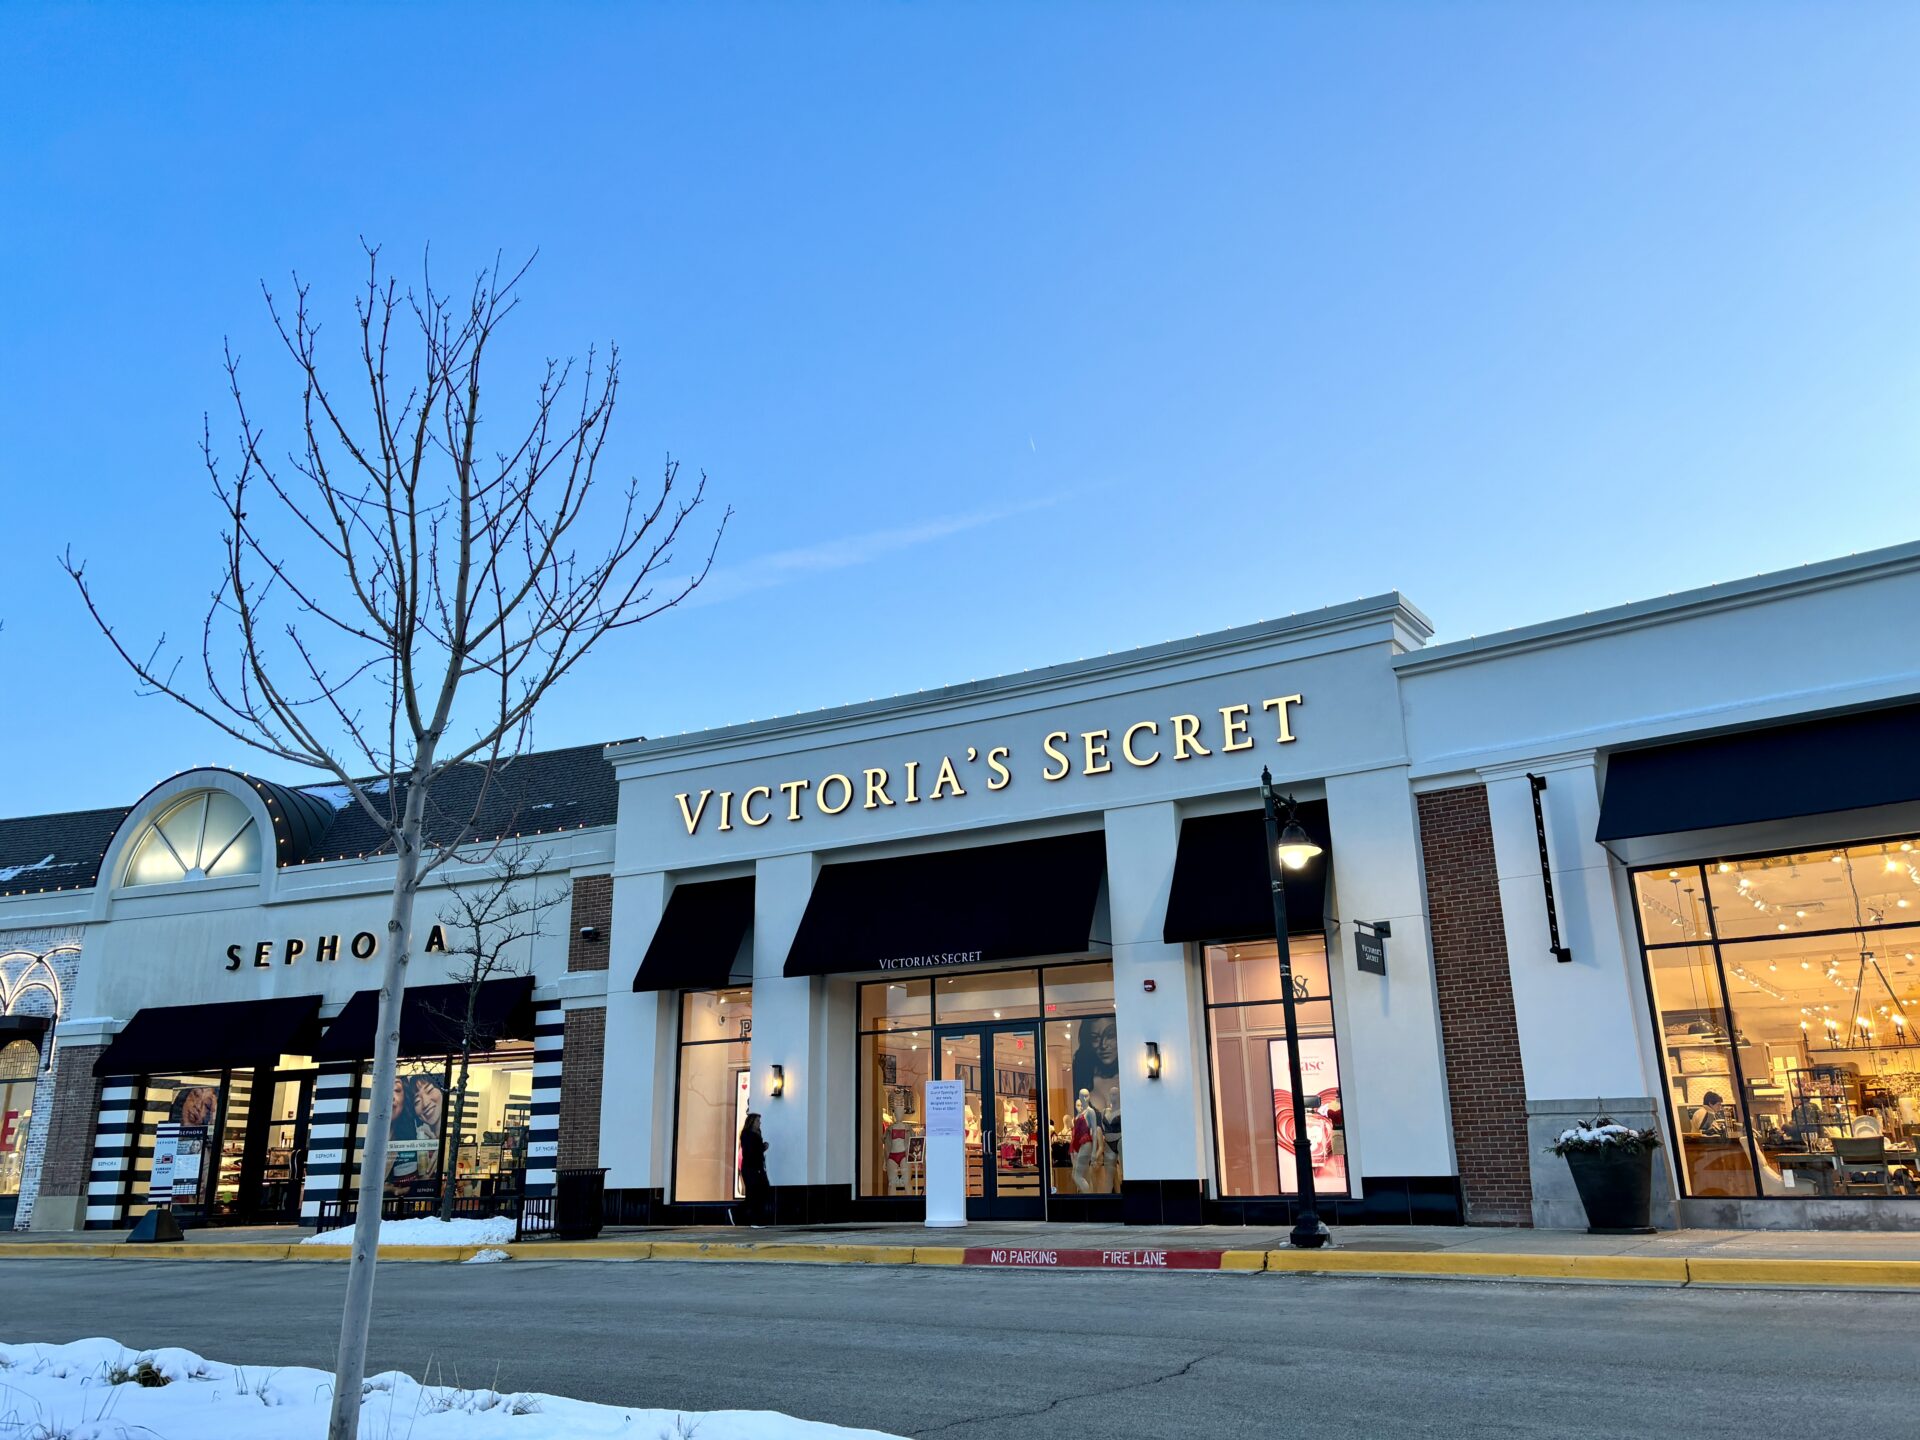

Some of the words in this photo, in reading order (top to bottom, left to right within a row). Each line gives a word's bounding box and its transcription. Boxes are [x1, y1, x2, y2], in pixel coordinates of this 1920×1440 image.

[675, 746, 1011, 836] VICTORIA'S
[1042, 694, 1303, 781] SECRET
[225, 924, 447, 971] SEPHOA
[879, 954, 940, 969] VICTORIA'S
[941, 950, 982, 964] SECRET
[990, 1250, 1007, 1263] NO
[1009, 1250, 1058, 1264] PARKING
[1102, 1251, 1131, 1265] FIRE
[1133, 1251, 1168, 1266] LANE
